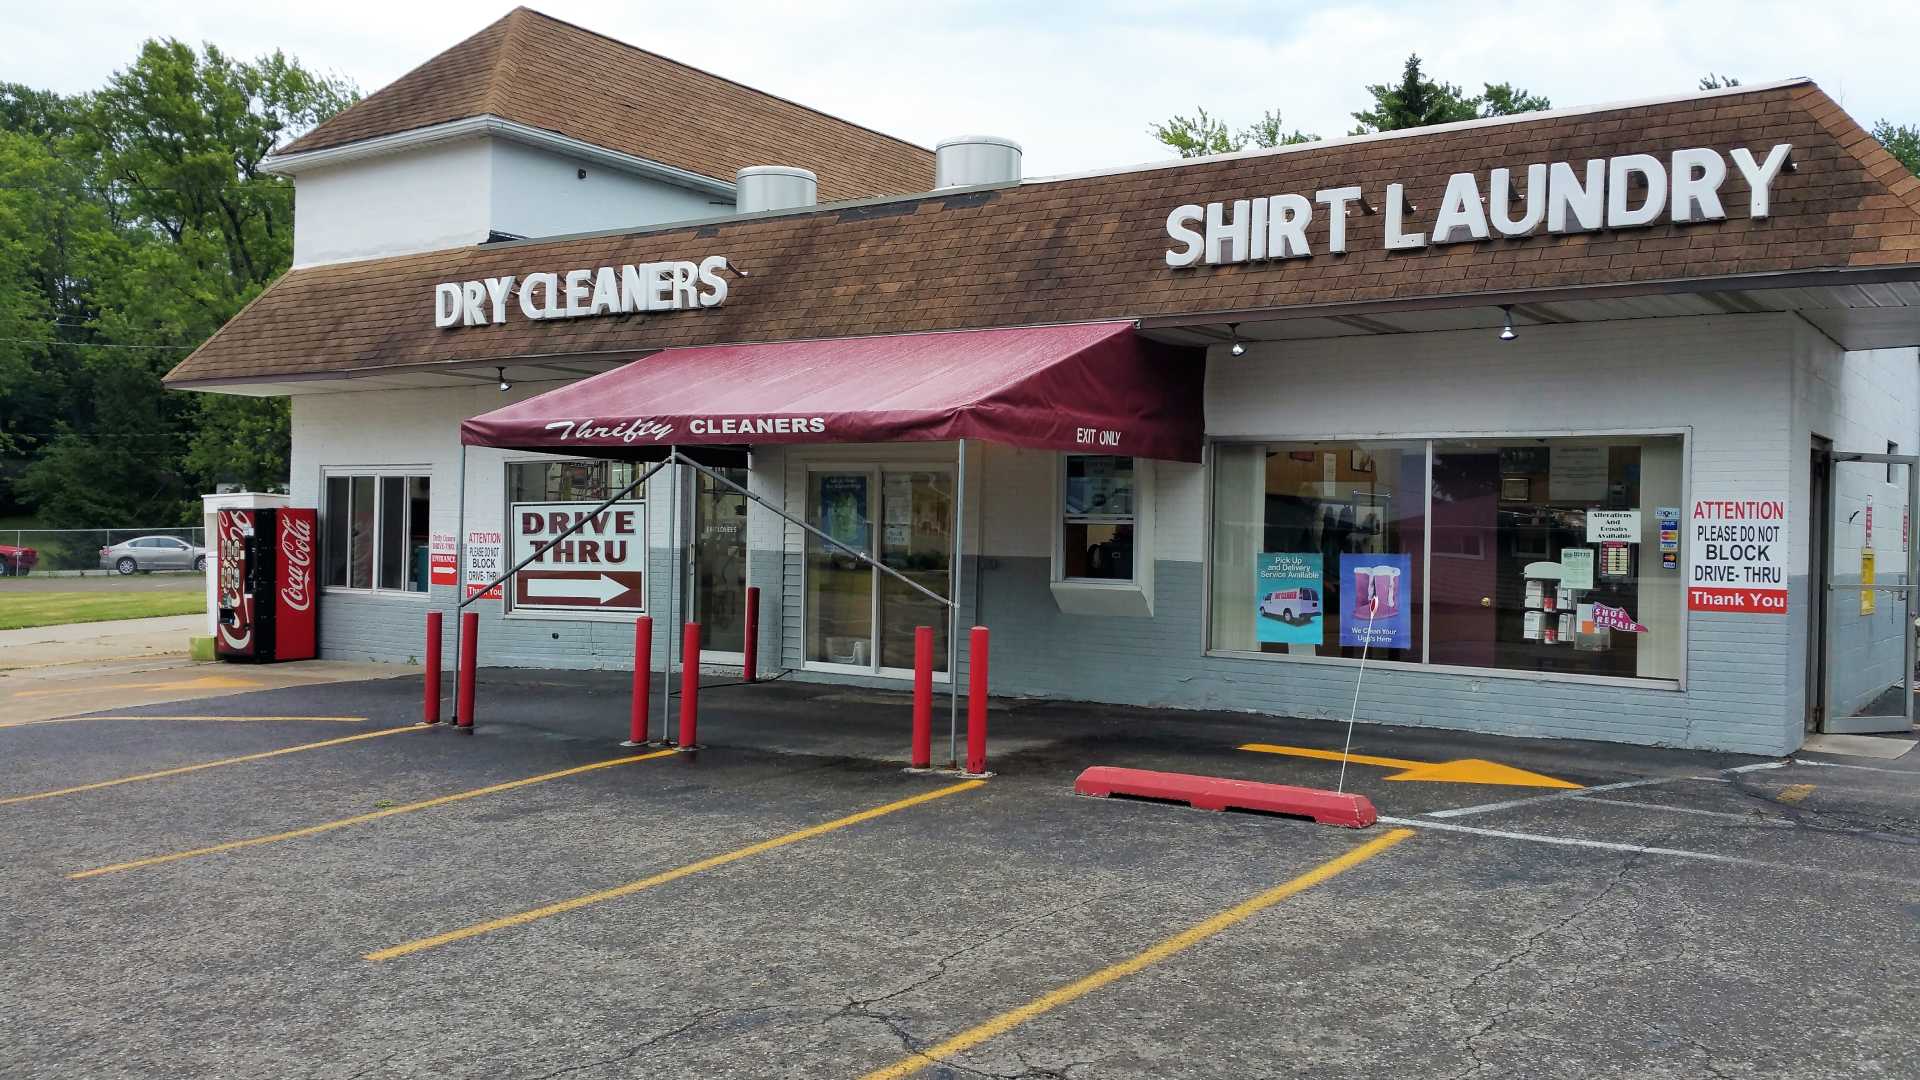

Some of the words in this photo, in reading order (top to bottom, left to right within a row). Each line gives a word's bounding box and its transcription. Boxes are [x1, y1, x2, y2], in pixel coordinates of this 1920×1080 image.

[1166, 186, 1361, 268] SHIRT
[1384, 143, 1793, 250] LAUNDRY
[436, 275, 516, 328] DRY
[519, 256, 728, 320] CLEANERS
[545, 418, 675, 443] Thrifty
[689, 417, 825, 435] CLEANERS
[1077, 427, 1097, 444] EXIT
[1099, 430, 1121, 446] ONLY
[1693, 501, 1784, 520] ATTENTION
[522, 511, 635, 535] DRIVE
[469, 532, 502, 544] ATTENTION
[1697, 525, 1737, 542] PLEASE
[1740, 526, 1755, 542] DO
[1758, 526, 1780, 542] NOT
[530, 540, 628, 563] THRU
[1706, 544, 1770, 561] BLOCK
[281, 514, 310, 611] Coca-Cola
[472, 558, 496, 569] BLOCK
[1291, 556, 1303, 565] Up
[1260, 570, 1287, 578] Service
[1288, 571, 1320, 579] Available
[1743, 566, 1781, 583] THRU
[490, 586, 502, 596] You
[1692, 591, 1745, 606] Thank
[1750, 593, 1784, 608] You
[1595, 608, 1625, 619] SHOE
[1597, 616, 1637, 631] REPAIR
